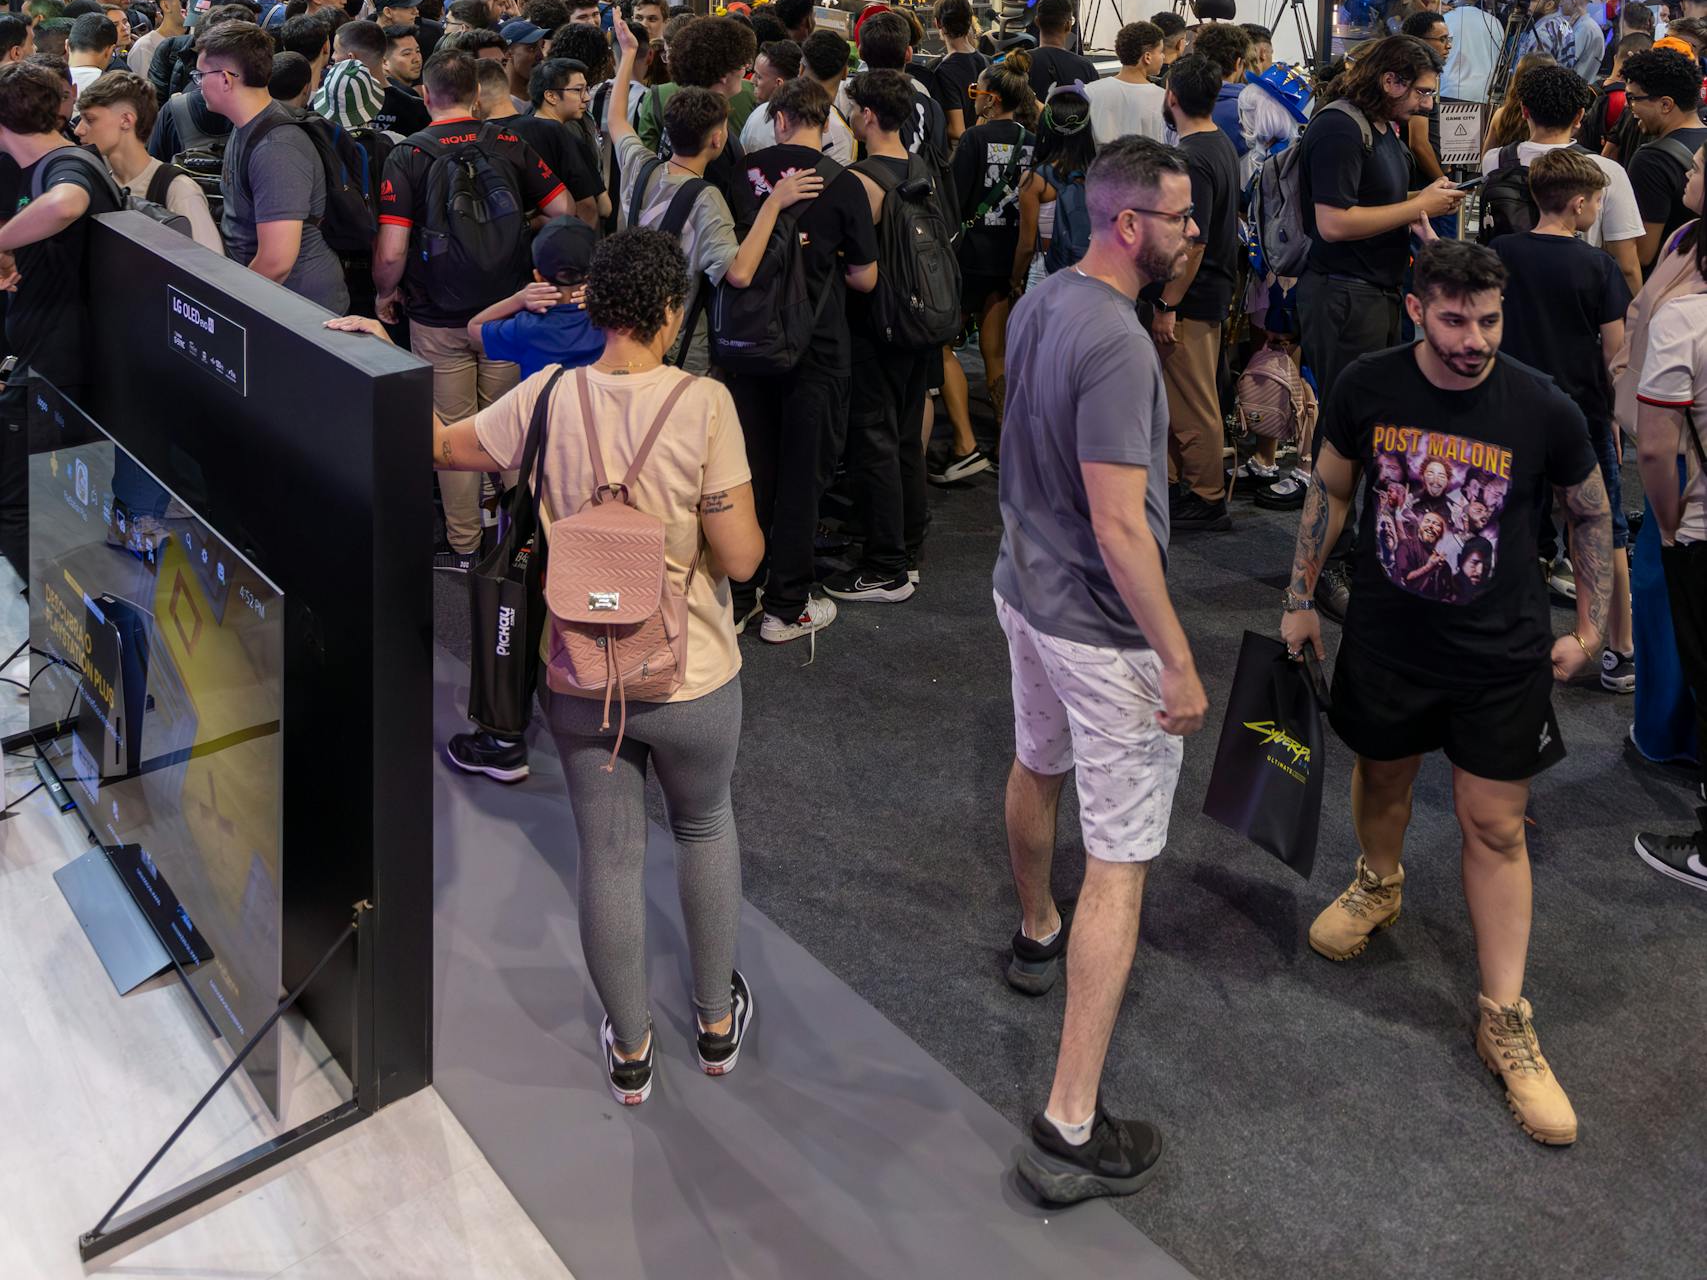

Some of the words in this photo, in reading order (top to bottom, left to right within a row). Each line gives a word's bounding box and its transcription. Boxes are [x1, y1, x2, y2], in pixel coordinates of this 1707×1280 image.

[173, 296, 182, 315] LG
[182, 302, 200, 325] OLED
[1373, 425, 1423, 454] POST
[1428, 431, 1514, 481] MALONE
[240, 585, 254, 609] 4:52
[254, 598, 265, 620] PM
[84, 632, 93, 655] O
[94, 670, 115, 710] PLUS
[1266, 754, 1293, 775] ULTIMATE
